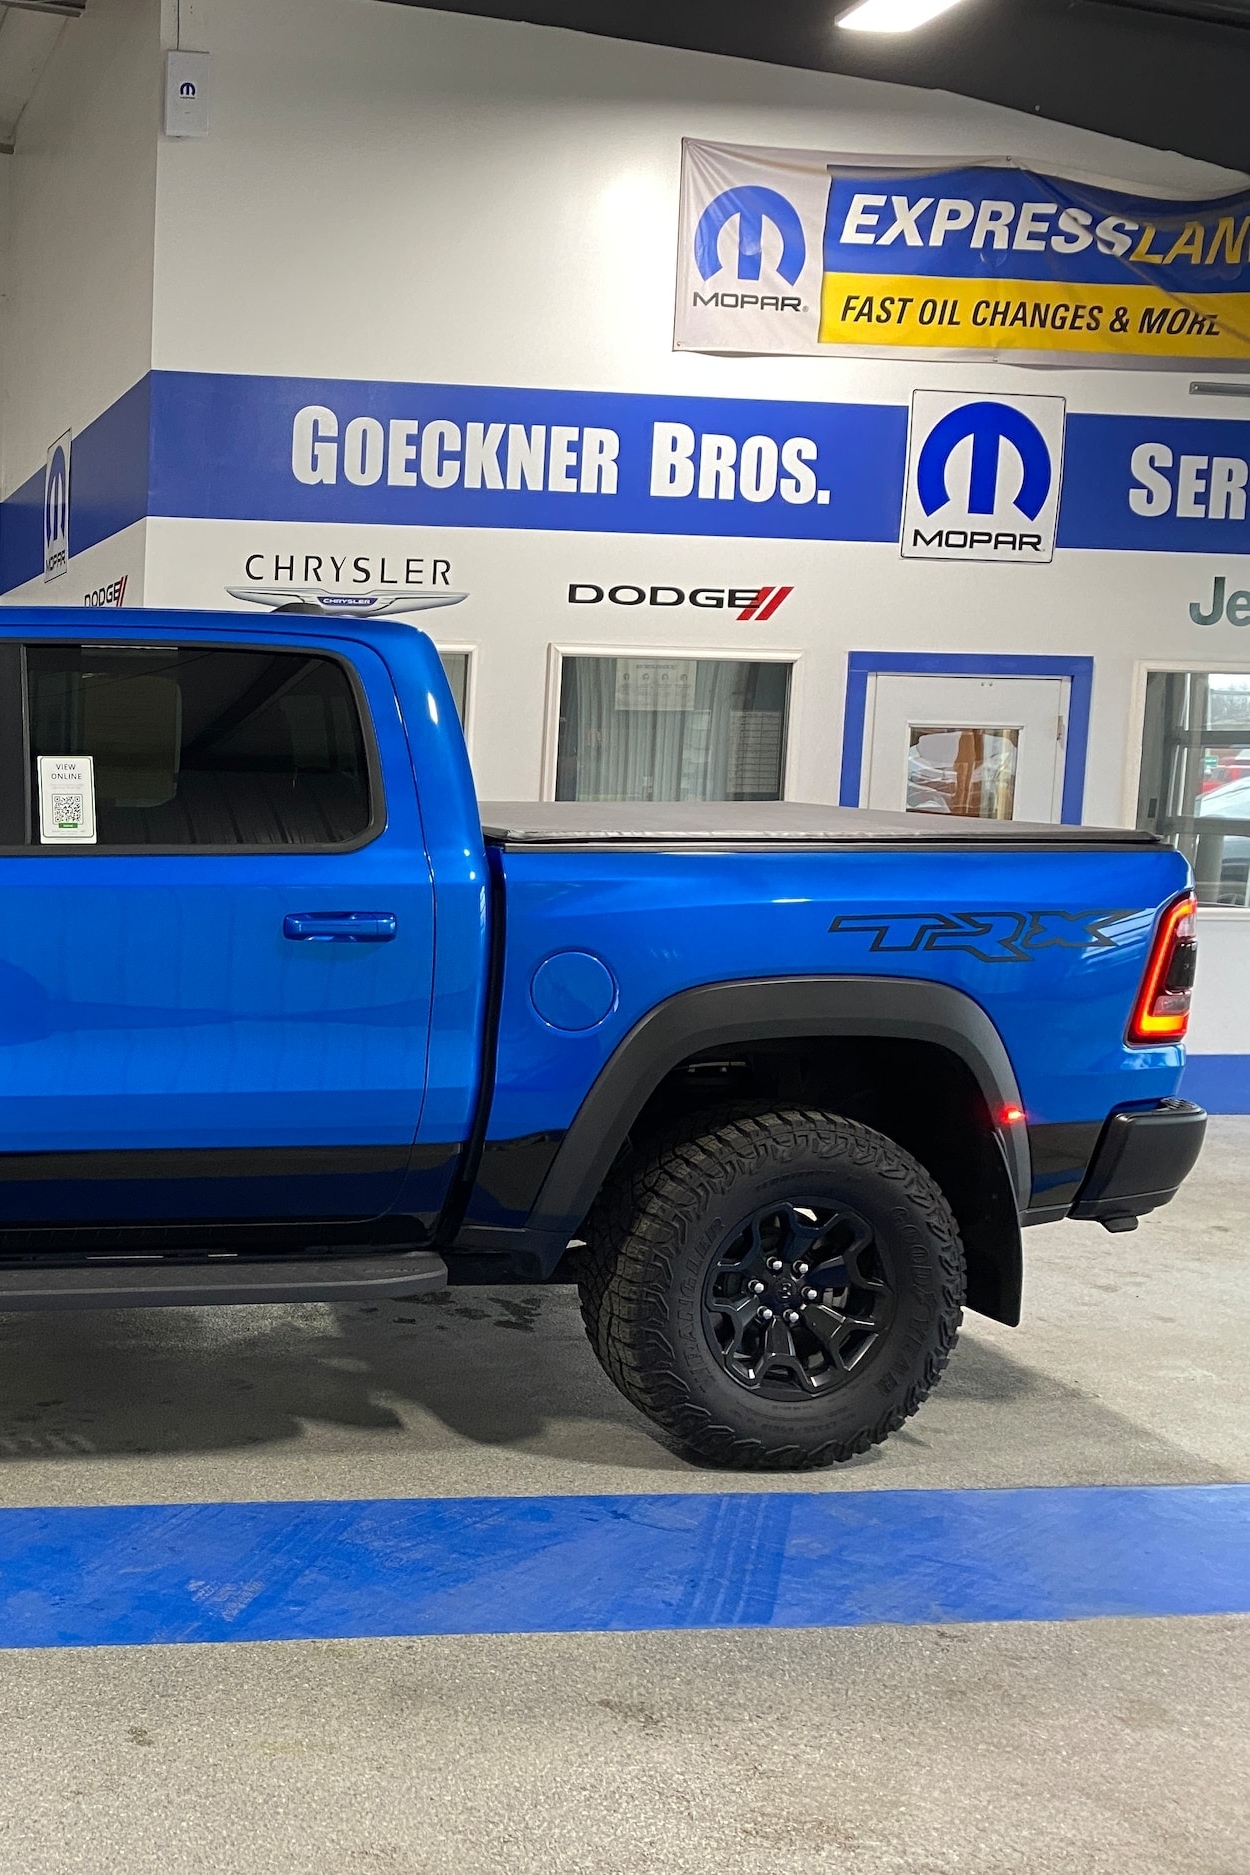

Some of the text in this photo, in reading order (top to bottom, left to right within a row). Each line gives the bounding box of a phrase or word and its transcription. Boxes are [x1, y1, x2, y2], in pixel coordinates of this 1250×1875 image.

[841, 295, 1221, 336] FAST OIL CHANGES & MORE
[291, 405, 621, 495] GOECKNER
[650, 421, 831, 505] BROS.
[912, 528, 1044, 552] MOPAR
[45, 549, 66, 572] MOPAR
[245, 554, 451, 586] CHRYSLER
[322, 597, 372, 605] CHRYSLER
[568, 583, 762, 609] DODGE
[56, 763, 76, 771] VIEW
[828, 908, 1142, 963] TRX
